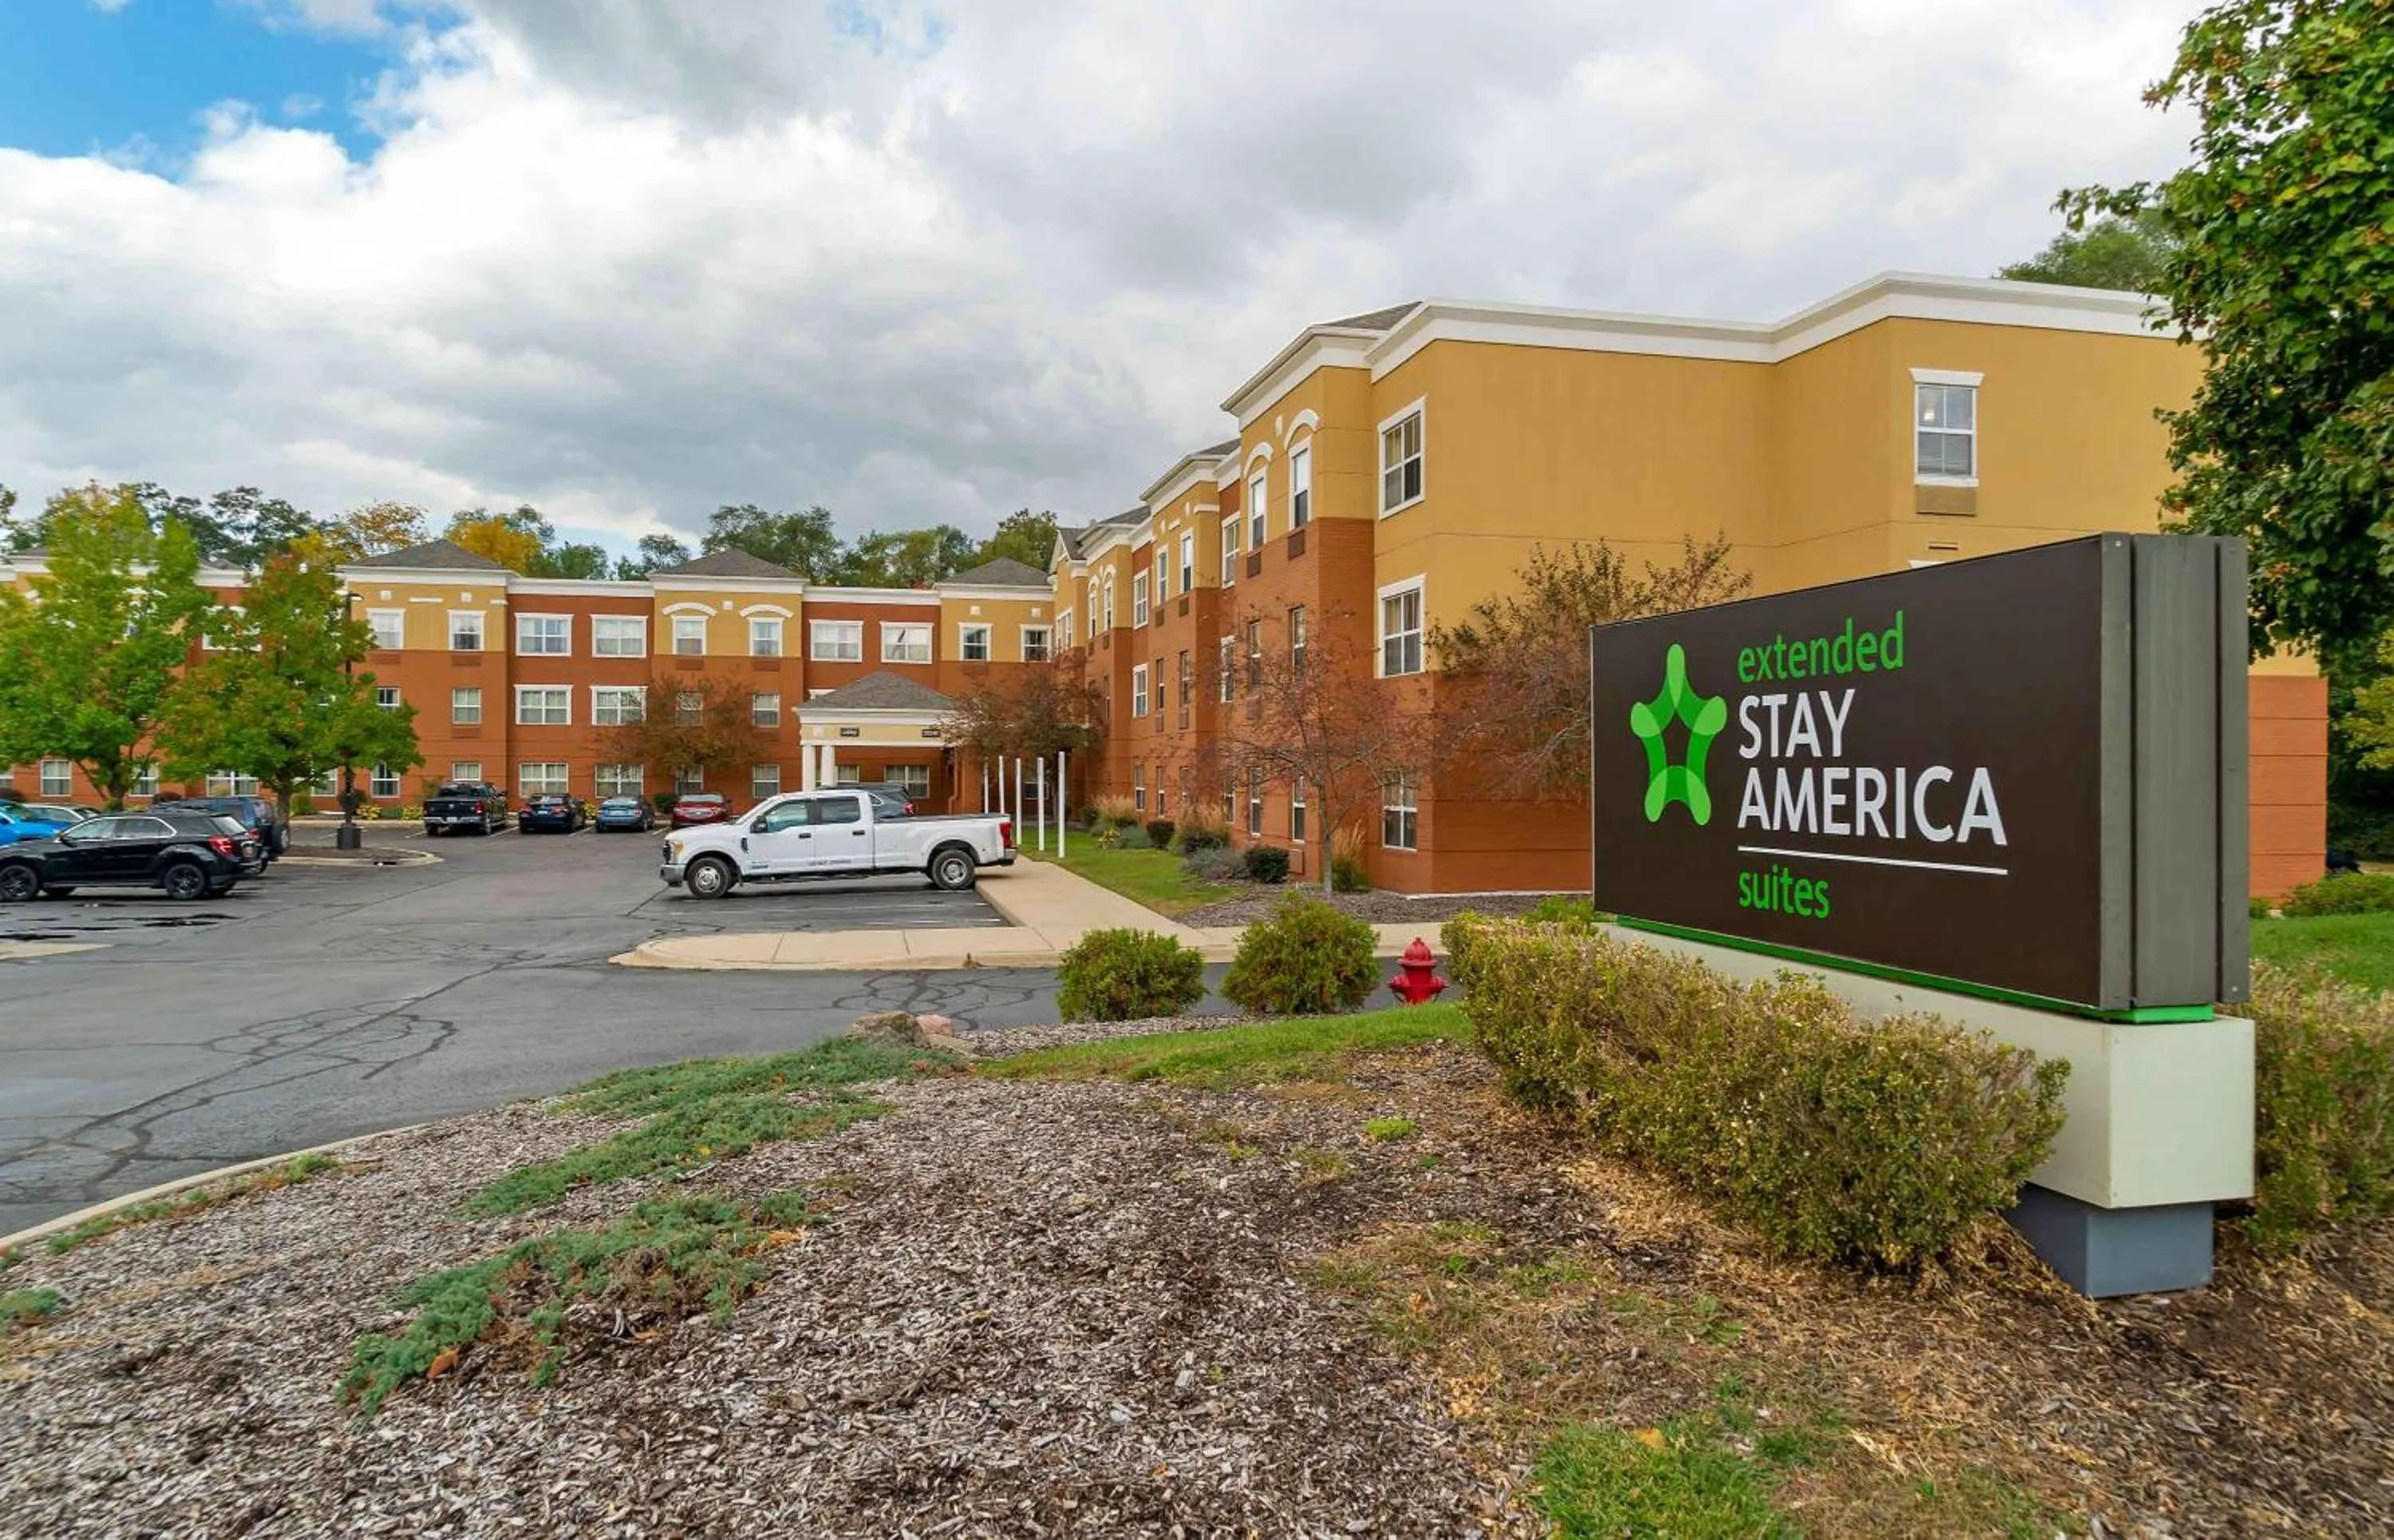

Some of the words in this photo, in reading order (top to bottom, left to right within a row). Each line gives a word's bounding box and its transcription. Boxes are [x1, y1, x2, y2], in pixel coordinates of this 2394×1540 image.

[1738, 610, 1904, 683] extended
[1739, 689, 1855, 759] STAY
[1737, 766, 2008, 846] AMERICA
[1738, 864, 1830, 919] suites
